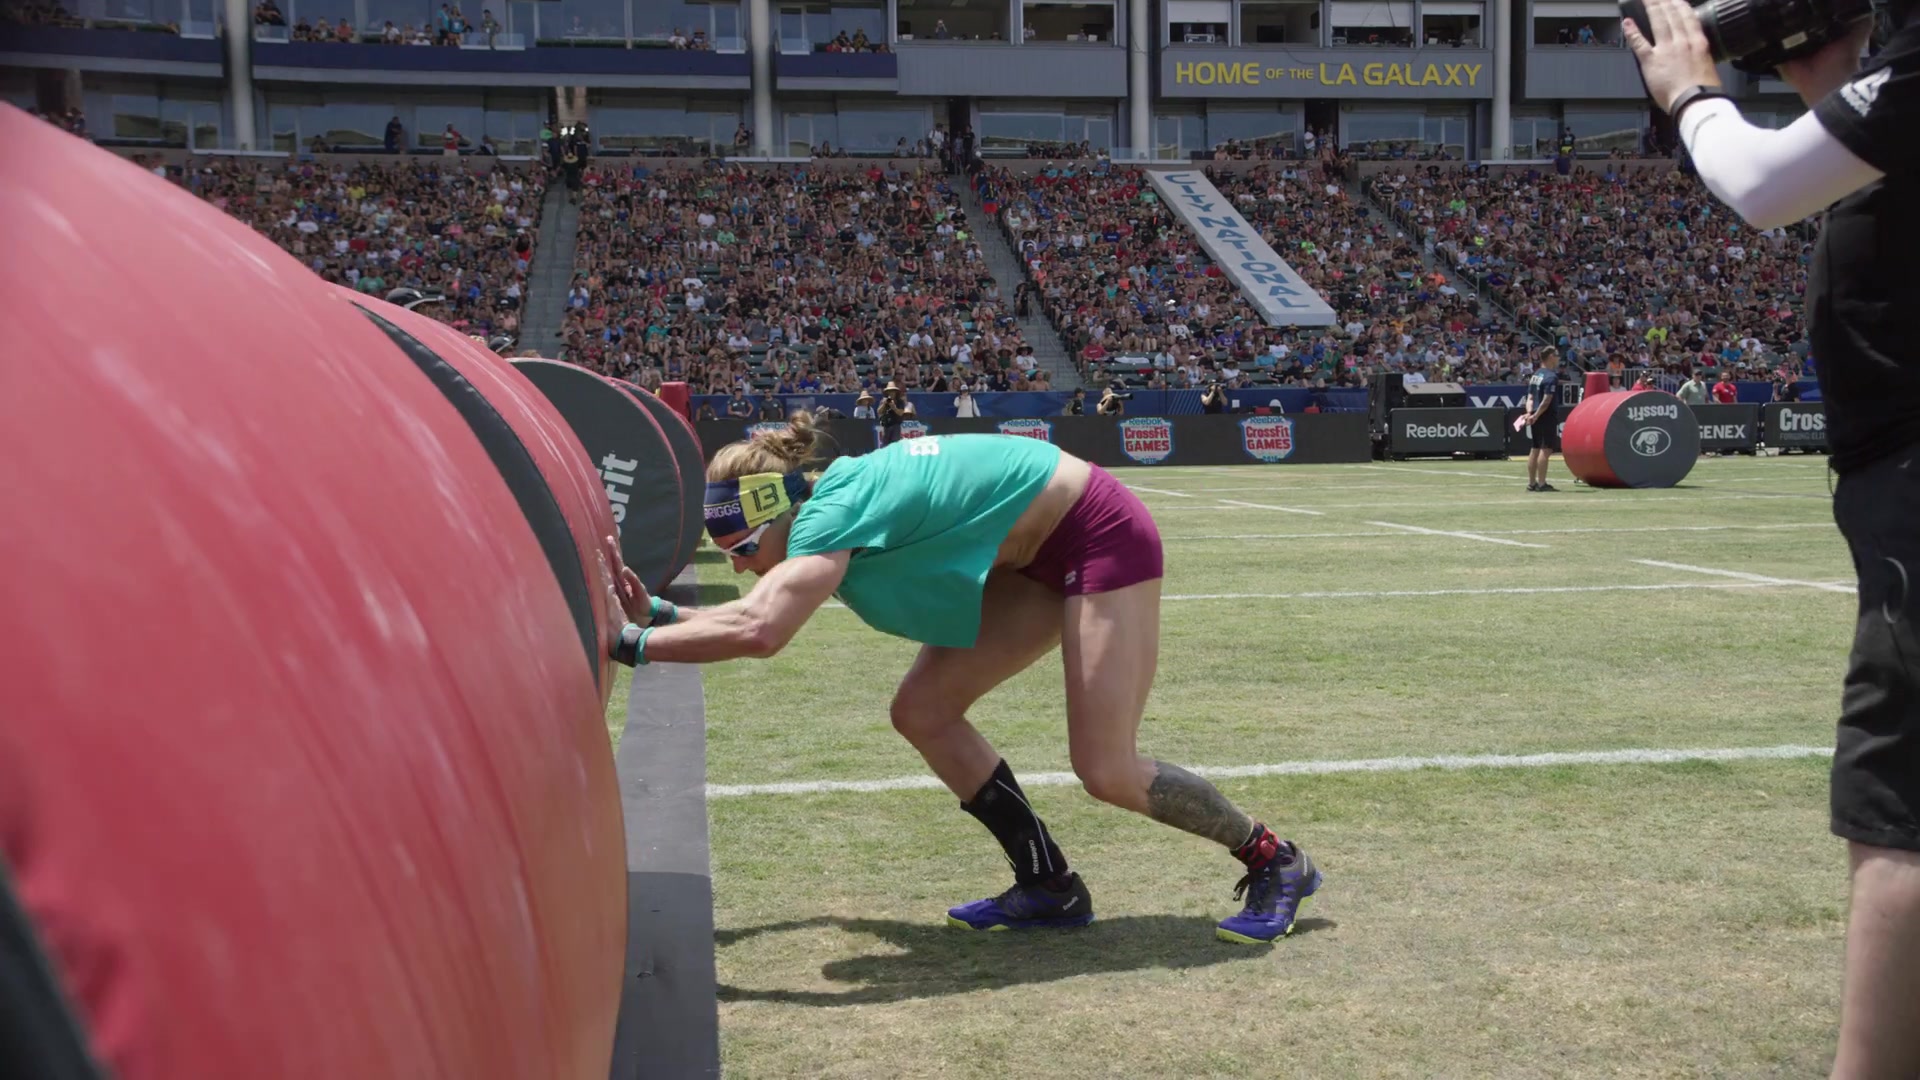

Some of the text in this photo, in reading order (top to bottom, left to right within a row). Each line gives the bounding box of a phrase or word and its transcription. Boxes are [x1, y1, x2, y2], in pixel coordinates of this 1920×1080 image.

[1176, 62, 1482, 86] HOME OF THE LA GALAXY
[1164, 174, 1310, 308] CITY NATIONAL
[1627, 404, 1678, 421] CrossFit
[1780, 408, 1827, 431] Cros
[1124, 427, 1169, 439] CrossFit
[1246, 425, 1289, 438] CrossFit
[1406, 423, 1468, 438] Reebok
[1125, 440, 1170, 452] GAMES
[1247, 439, 1291, 450] GAMES
[751, 483, 780, 512] 13
